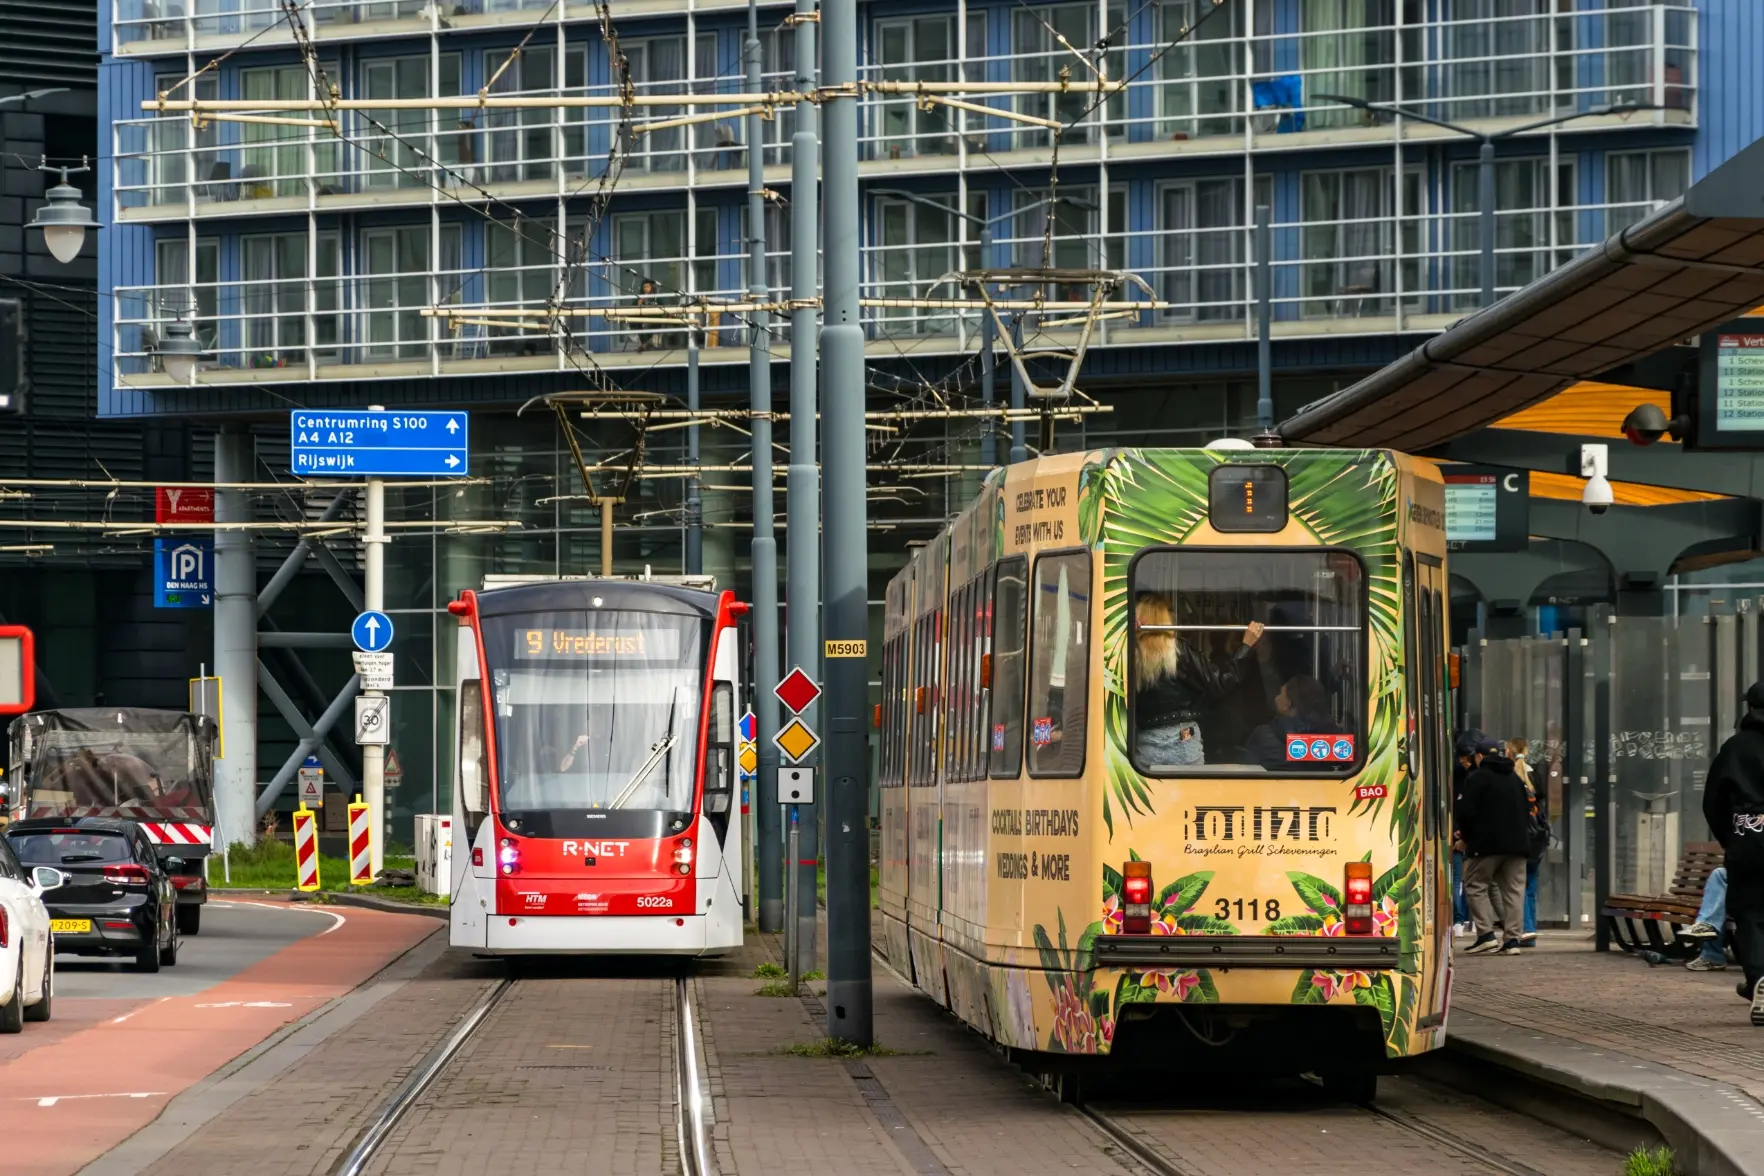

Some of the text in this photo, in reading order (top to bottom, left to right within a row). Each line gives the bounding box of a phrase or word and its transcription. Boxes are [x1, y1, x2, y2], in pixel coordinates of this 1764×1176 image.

[1737, 367, 1764, 376] Statio
[1723, 389, 1764, 397] 12 Statio
[1737, 400, 1764, 408] Statio
[1723, 410, 1764, 418] 12 Statio
[297, 416, 428, 432] Centrumring S100
[298, 432, 354, 444] A4 A12
[298, 454, 355, 470] Rijswijk
[1503, 473, 1519, 492] C
[165, 489, 183, 514] Y
[1016, 487, 1066, 513] CELEBRATE YOUR
[1015, 520, 1064, 546] EVENTS WITH US
[180, 554, 196, 580] P
[166, 581, 179, 589] DEN
[526, 631, 645, 654] 9 Vrederust
[827, 644, 865, 655] M5903
[363, 715, 379, 726] 30
[1360, 787, 1383, 798] BAO
[992, 809, 1079, 837] COCKTAILS BIRTHDAYS
[1184, 843, 1338, 859] Brazilian Grill Scheveningen
[997, 850, 1070, 881] WEDDINGS & MORE
[525, 894, 547, 904] HTM
[636, 896, 673, 908] 5022a
[1214, 898, 1281, 922] 3118
